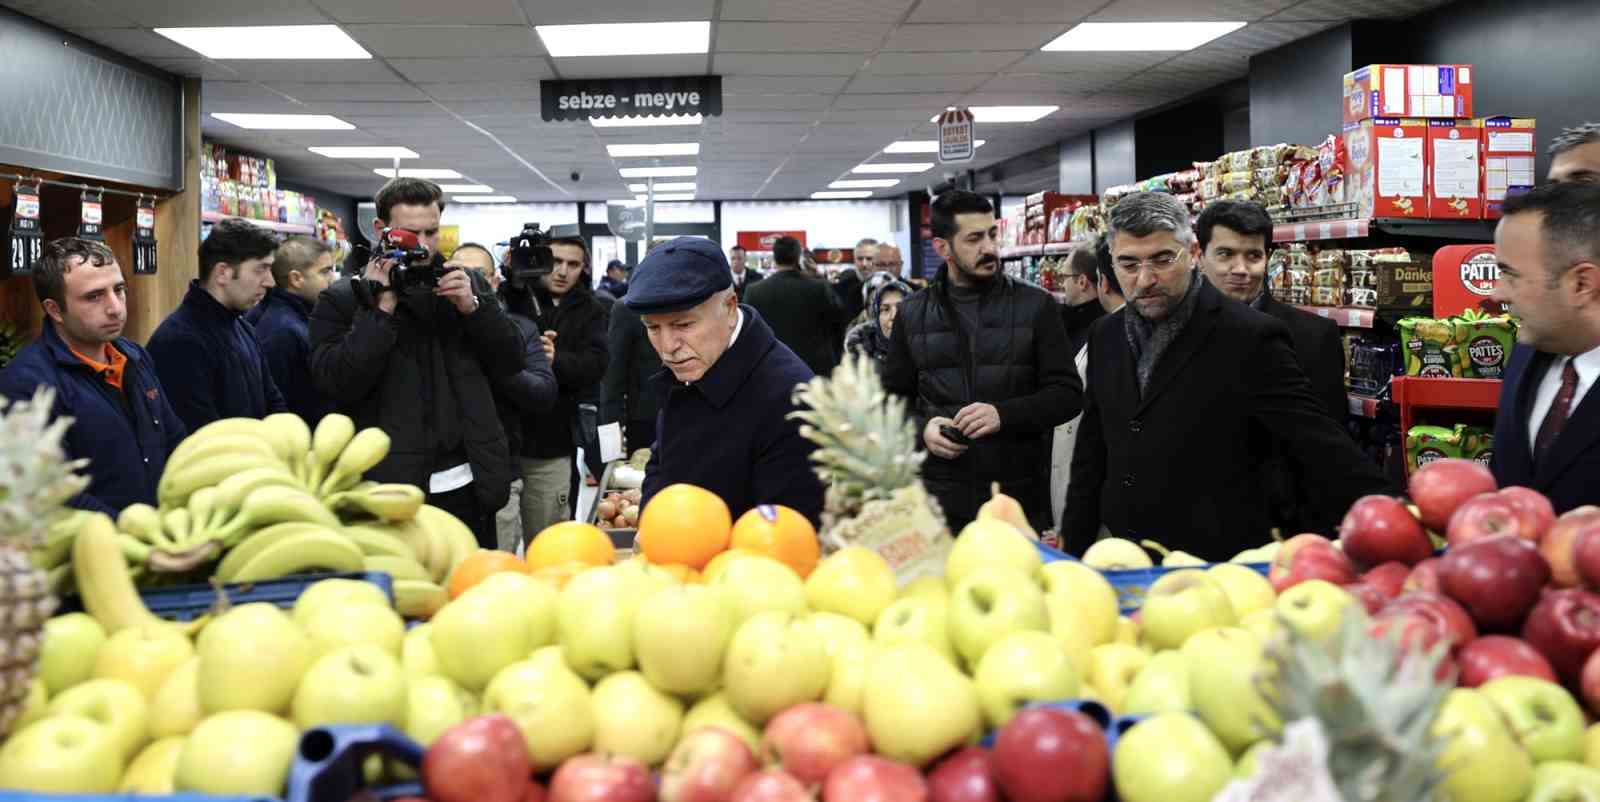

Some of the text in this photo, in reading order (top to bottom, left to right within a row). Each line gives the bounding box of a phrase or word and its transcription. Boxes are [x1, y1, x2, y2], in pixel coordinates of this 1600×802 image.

[559, 91, 616, 109] sebze
[634, 92, 700, 109] meyve
[12, 238, 24, 268] 29
[1460, 263, 1502, 280] PATTE
[1469, 344, 1504, 358] PATTES
